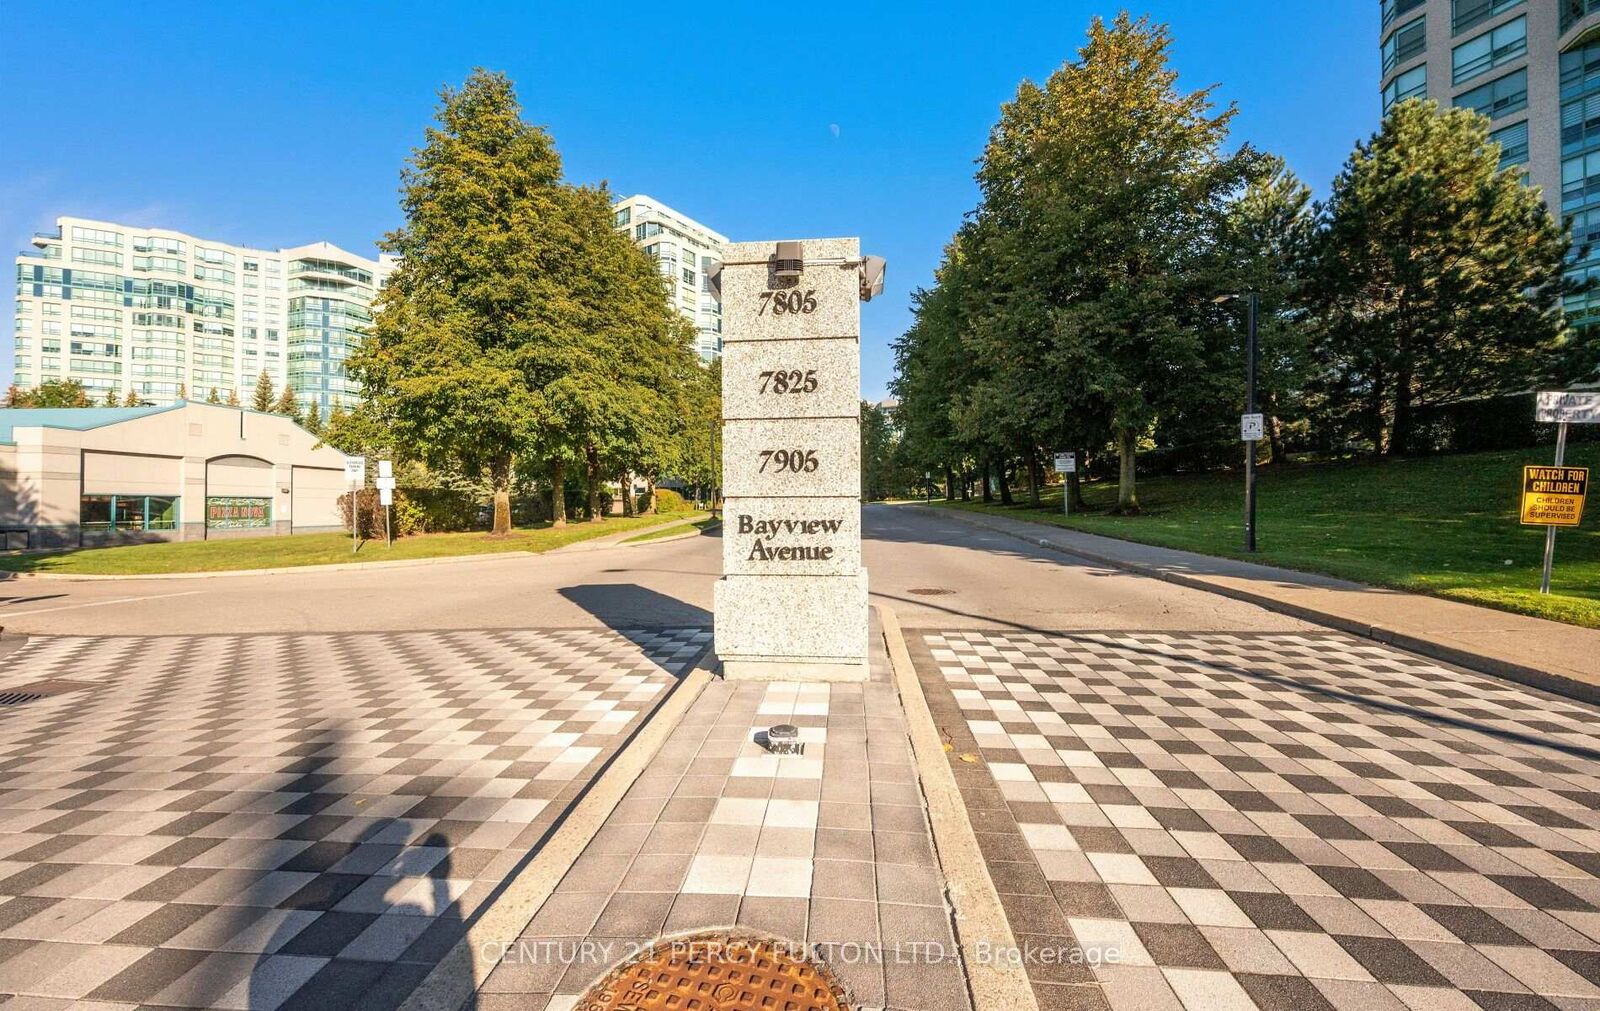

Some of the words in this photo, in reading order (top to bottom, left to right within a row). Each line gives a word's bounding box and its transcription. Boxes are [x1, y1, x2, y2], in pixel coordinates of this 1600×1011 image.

[758, 290, 817, 316] 7805
[758, 369, 819, 395] 7825
[758, 449, 819, 474] 7905
[1529, 469, 1564, 480] WATCH
[1567, 470, 1585, 482] FOR
[1532, 481, 1580, 493] CHILDREN
[1531, 504, 1565, 512] SHOULD
[1536, 497, 1575, 505] CHILDREN
[1529, 511, 1576, 520] SUPERVISED
[738, 514, 843, 540] Bayview
[748, 538, 833, 561] Avenue
